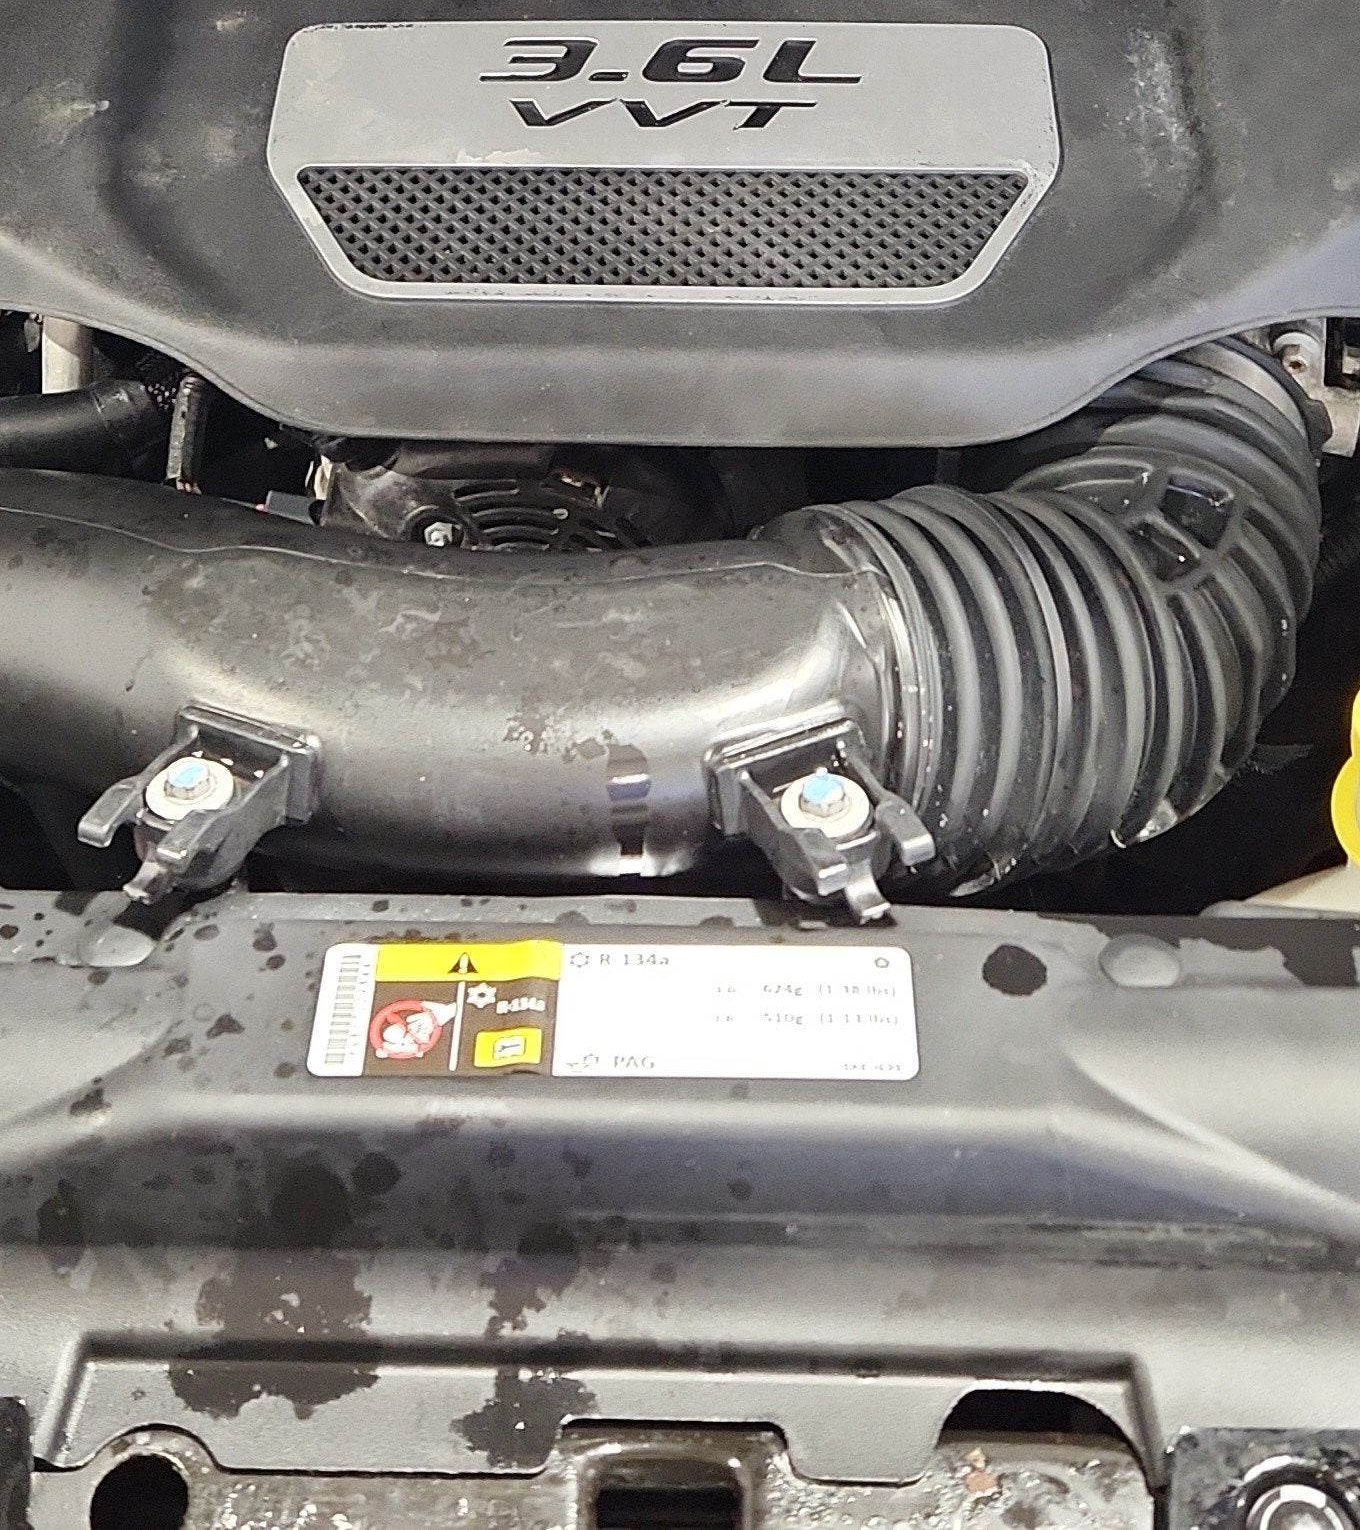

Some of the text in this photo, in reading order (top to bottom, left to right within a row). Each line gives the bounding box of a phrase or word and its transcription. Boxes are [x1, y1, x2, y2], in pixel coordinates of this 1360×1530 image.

[479, 37, 863, 85] 3.6L
[508, 97, 820, 132] VVT
[612, 1054, 656, 1070] PAG
